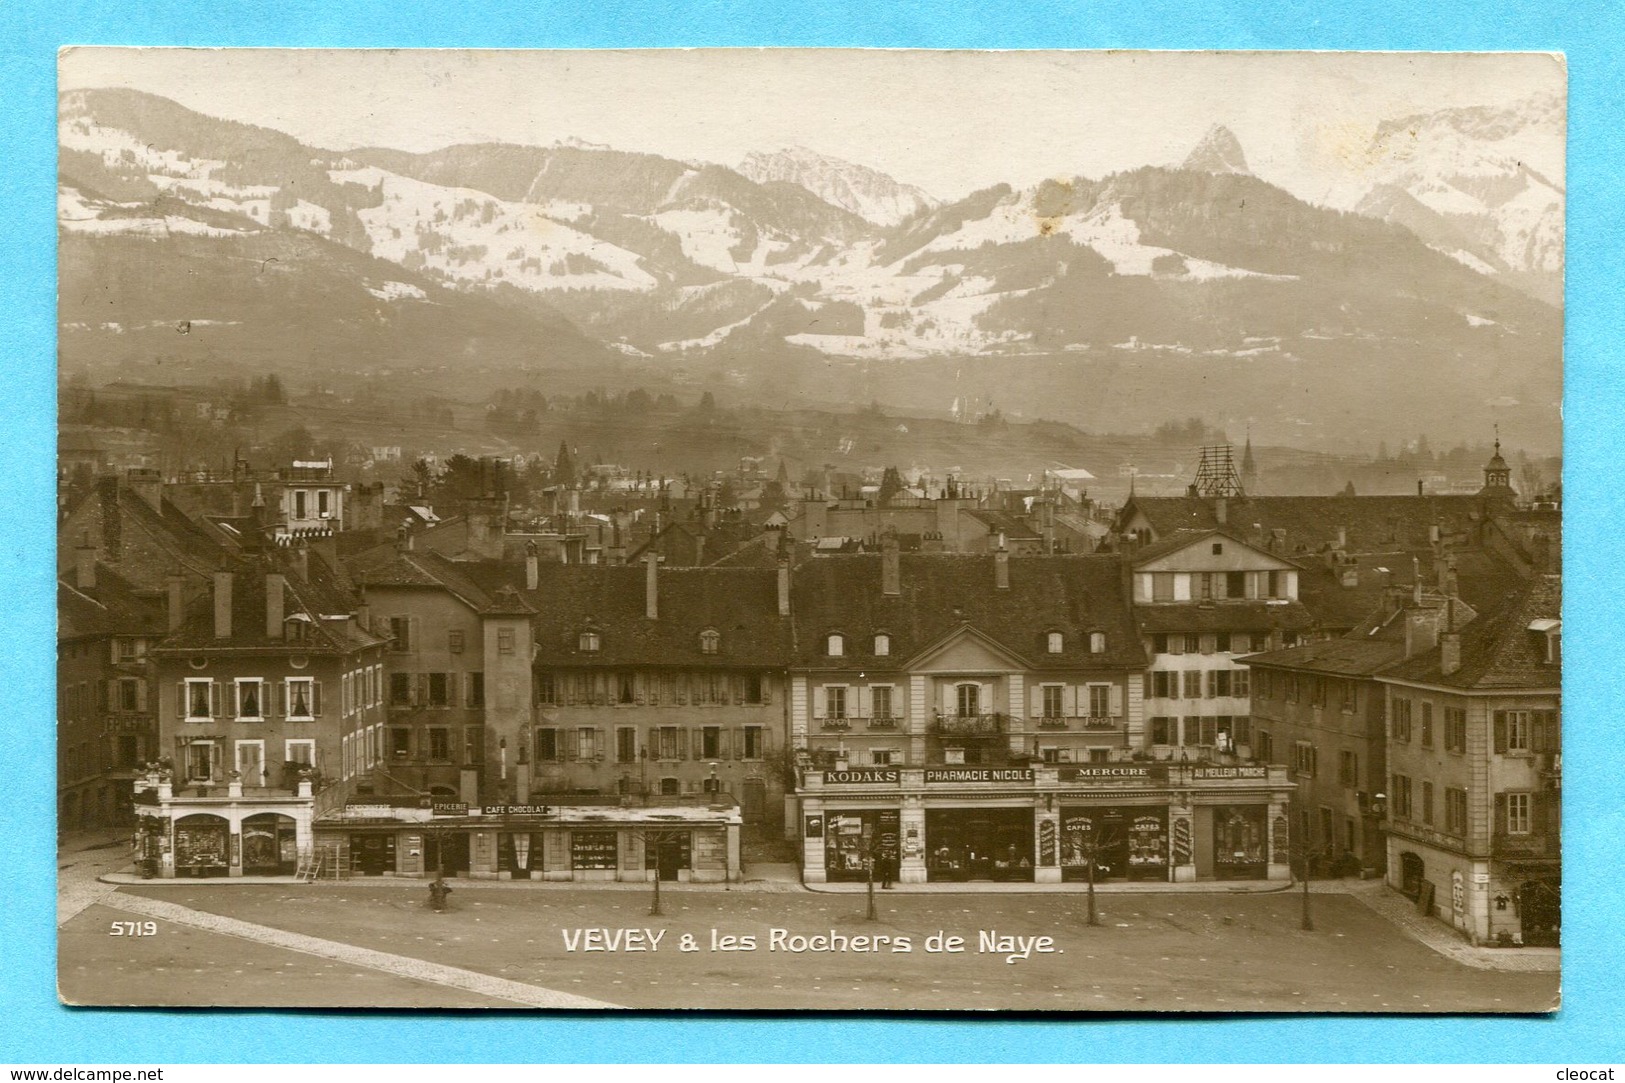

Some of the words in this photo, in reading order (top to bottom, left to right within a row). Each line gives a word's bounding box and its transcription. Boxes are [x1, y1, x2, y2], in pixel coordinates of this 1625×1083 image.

[827, 771, 897, 782] KODAKS
[927, 770, 990, 781] PHARMACIE
[992, 769, 1032, 780] NICOLE
[1194, 767, 1204, 777] AU
[1205, 767, 1237, 777] MEILLEUR
[434, 803, 468, 811] EPICERIE
[485, 806, 506, 814] CAFE
[508, 805, 545, 813] CHOCOLAT
